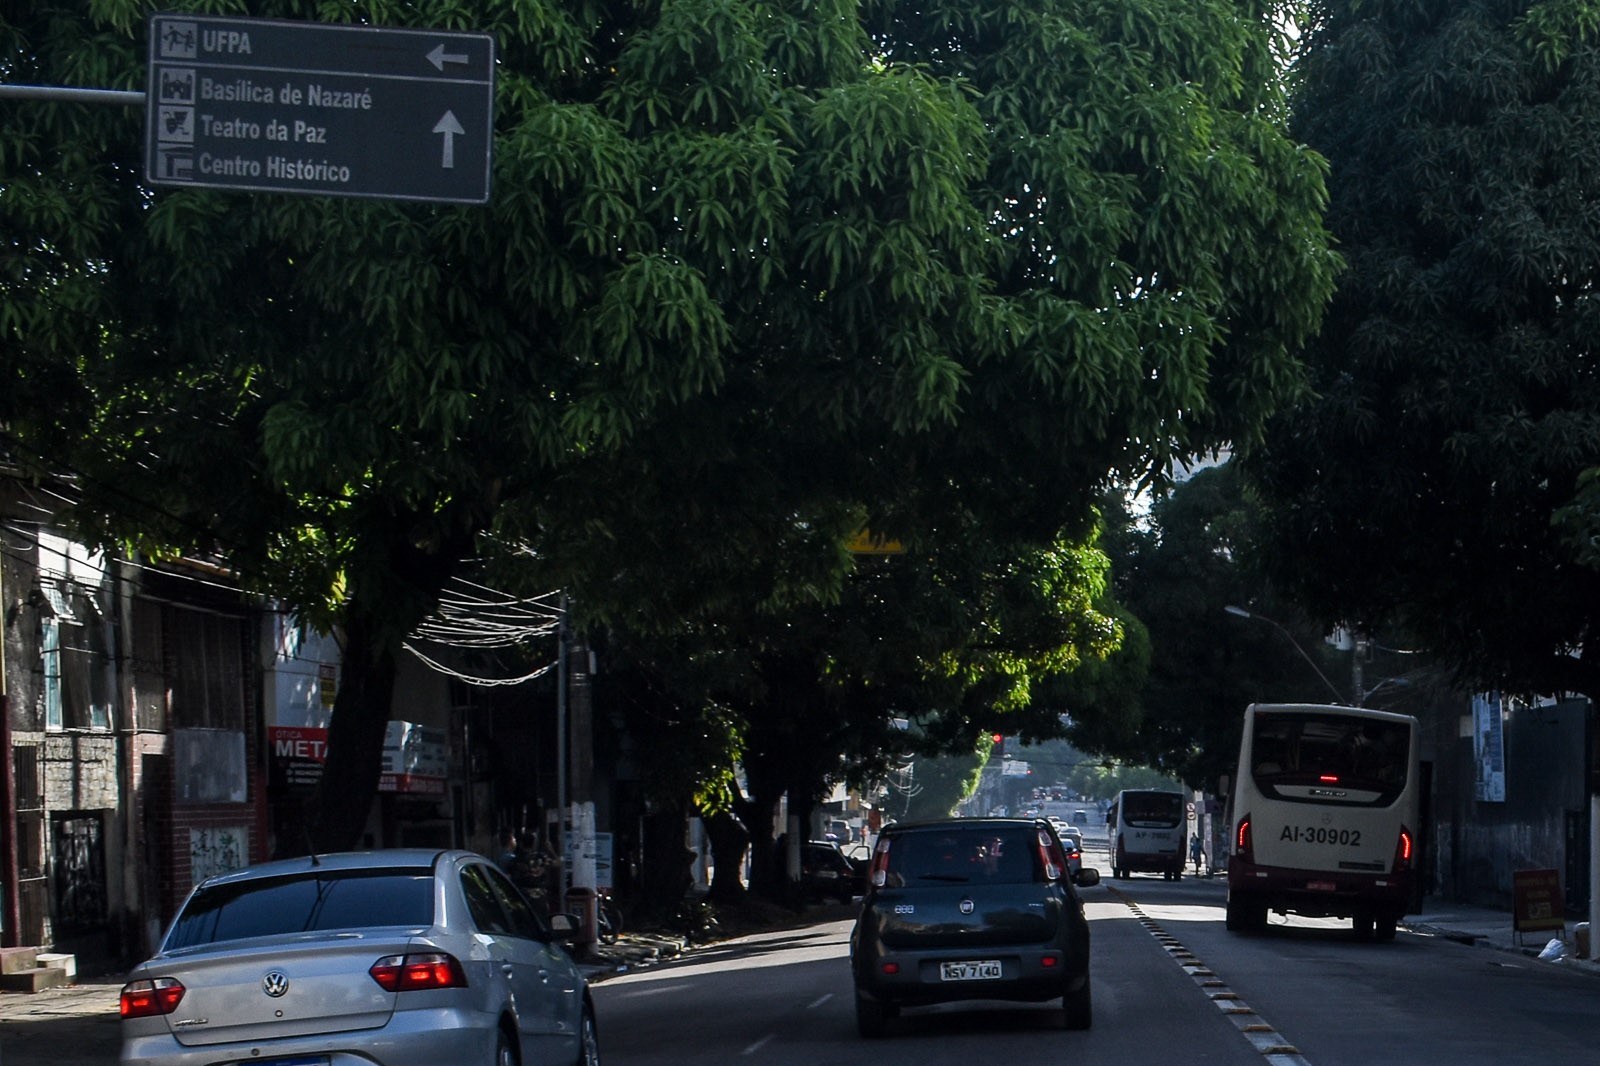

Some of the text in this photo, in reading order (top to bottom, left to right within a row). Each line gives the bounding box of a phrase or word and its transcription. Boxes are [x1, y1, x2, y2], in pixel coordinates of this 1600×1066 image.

[203, 29, 252, 54] UFPA
[201, 77, 373, 110] Basílica de Nazaré
[201, 114, 327, 144] Teatro da Paz
[199, 151, 350, 182] Centro Histórico
[275, 729, 303, 740] ÓTICA
[1280, 825, 1361, 847] AI-30902
